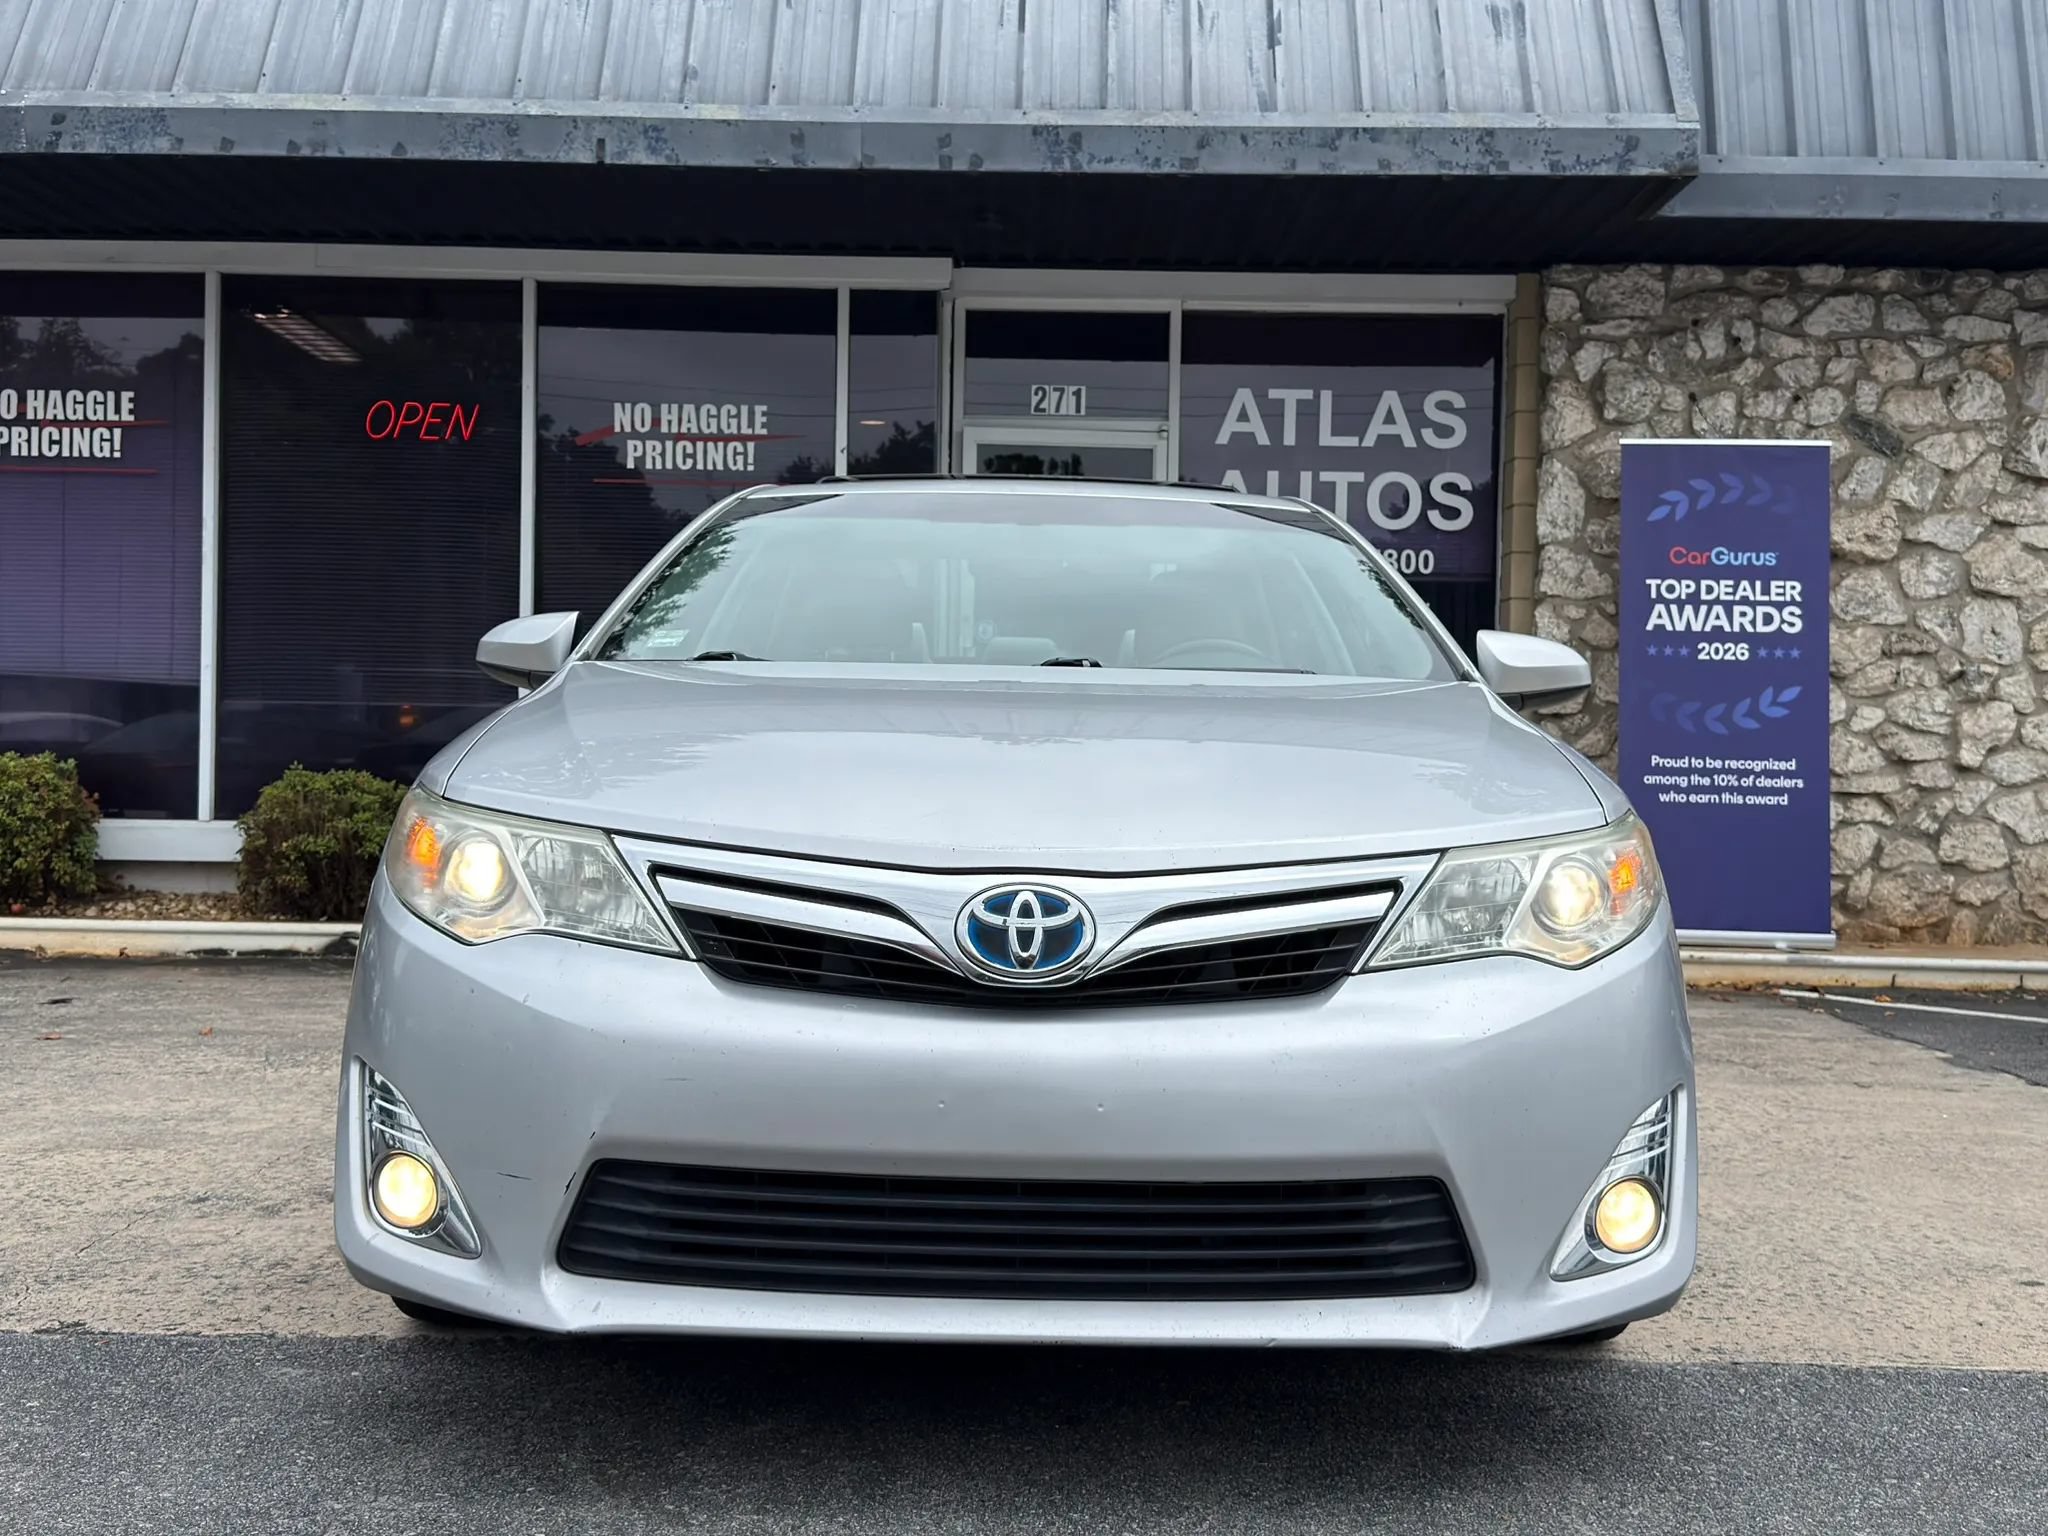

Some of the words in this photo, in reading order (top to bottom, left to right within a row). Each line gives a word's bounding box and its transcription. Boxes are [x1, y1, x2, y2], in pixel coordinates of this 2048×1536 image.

[0, 389, 18, 420] O
[26, 389, 136, 421] HAGGLE
[1033, 386, 1082, 414] 271
[366, 400, 480, 440] OPEN
[613, 402, 652, 433] NO
[660, 403, 768, 435] HAGGLE
[1215, 387, 1468, 450] ATLAS
[626, 439, 755, 471] PRICING!
[1377, 548, 1435, 575] 800
[1669, 546, 1778, 567] CarGurus
[1645, 578, 1697, 600] TOP
[1700, 580, 1802, 602] DEALER
[1645, 603, 1804, 634] AWARDS
[1697, 642, 1750, 661] 2026
[1651, 754, 1689, 768] Proud
[1691, 756, 1704, 768] to
[1706, 756, 1723, 769] be
[1724, 757, 1796, 772] recognized
[1643, 774, 1689, 788] among
[1690, 773, 1711, 786] the
[1713, 774, 1739, 787] 10%
[1740, 774, 1755, 787] of
[1755, 775, 1804, 789] dealers
[1658, 790, 1687, 803] who
[1688, 793, 1719, 804] earn
[1721, 791, 1744, 804] this
[1745, 793, 1788, 806] award
